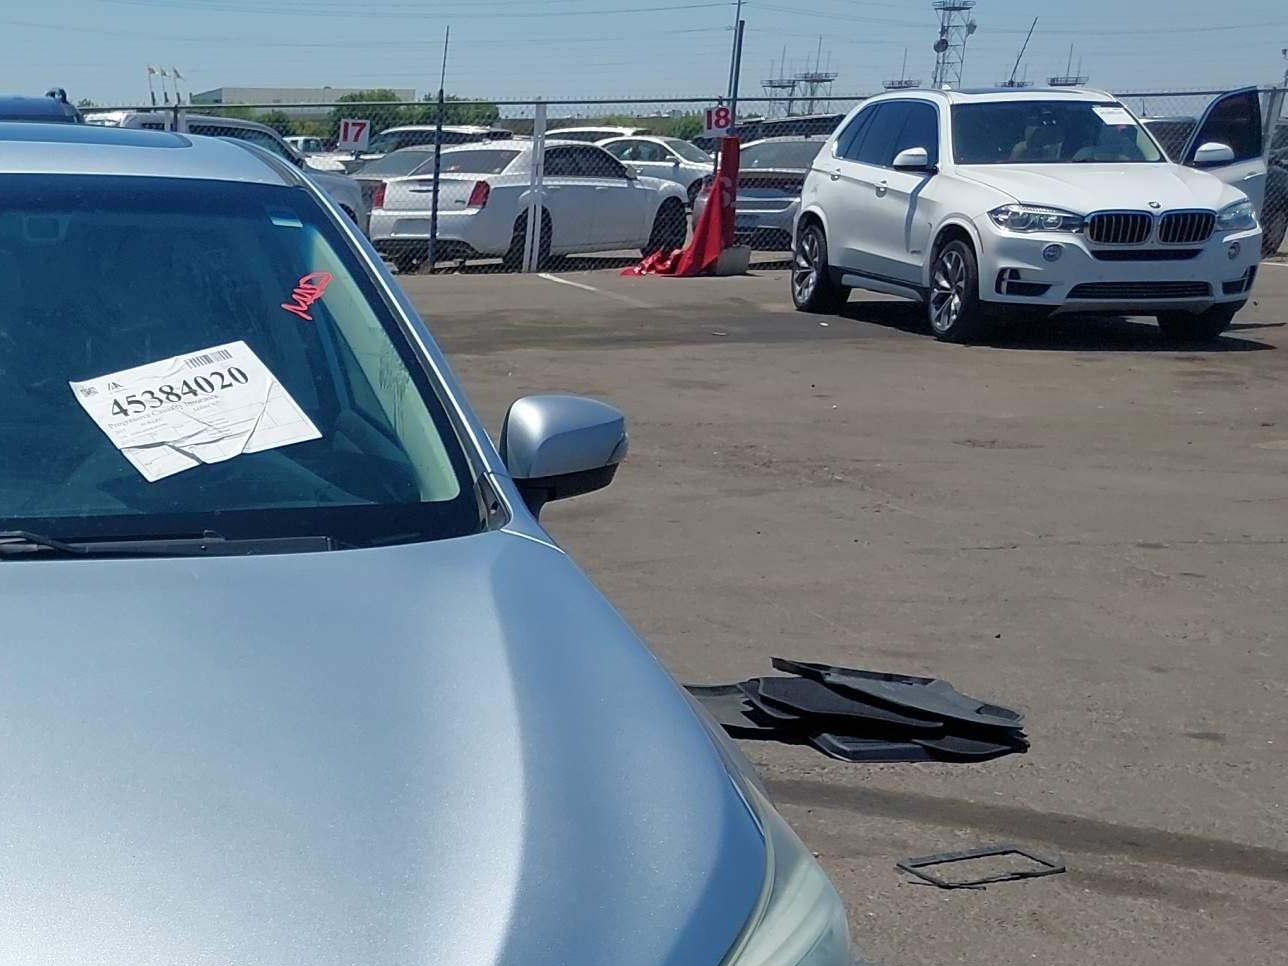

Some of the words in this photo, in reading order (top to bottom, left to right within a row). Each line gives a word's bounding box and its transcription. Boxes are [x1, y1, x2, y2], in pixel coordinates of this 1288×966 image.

[706, 107, 730, 130] 18
[342, 121, 367, 142] 17
[111, 366, 249, 417] 45384020
